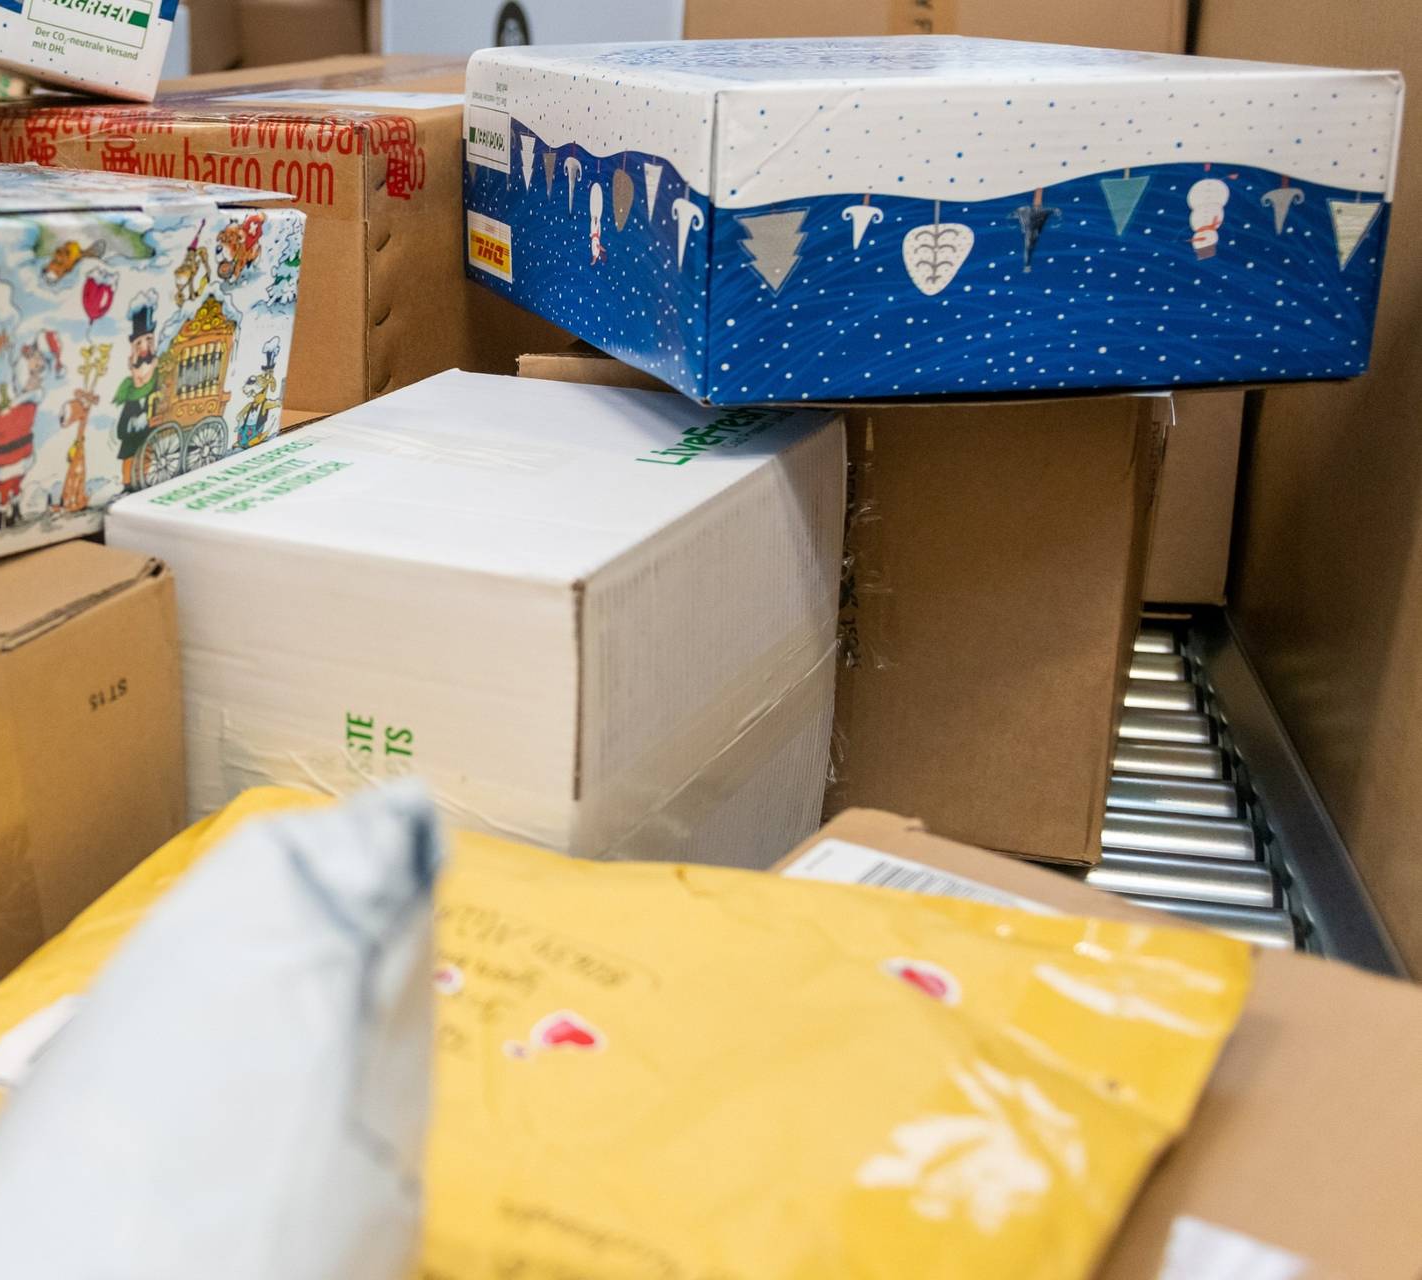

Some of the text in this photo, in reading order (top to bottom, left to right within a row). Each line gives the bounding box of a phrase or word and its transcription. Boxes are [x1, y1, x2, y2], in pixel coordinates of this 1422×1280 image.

[32, 40, 65, 55] mit DHL
[35, 26, 50, 38] Der
[106, 45, 139, 61] Versand
[474, 236, 504, 266] DHL
[636, 407, 795, 465] LiveFresh
